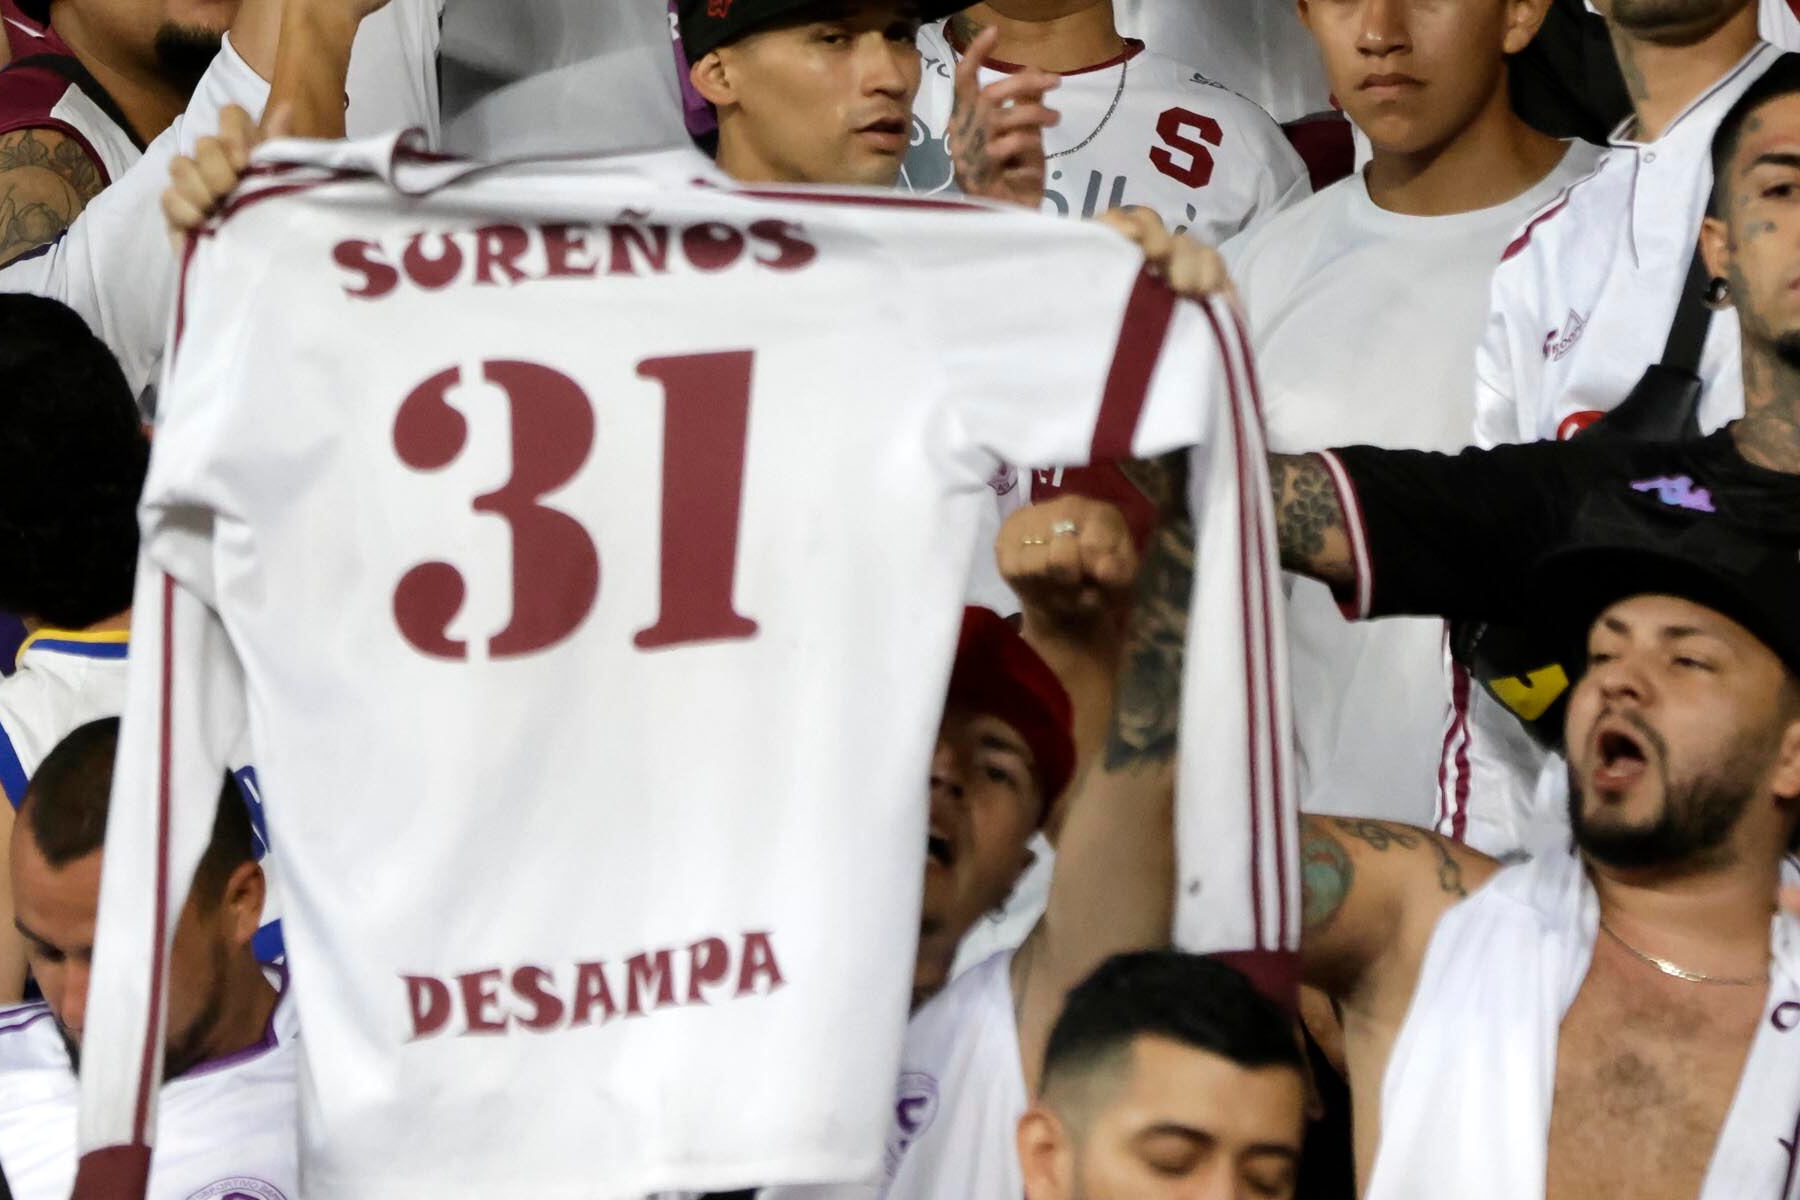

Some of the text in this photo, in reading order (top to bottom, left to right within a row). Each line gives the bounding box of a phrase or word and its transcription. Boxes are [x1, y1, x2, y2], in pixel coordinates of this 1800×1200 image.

[1149, 106, 1223, 188] S
[332, 208, 818, 300] SUREÑOS
[393, 349, 759, 662] 31
[399, 931, 787, 1041] DESAMPA
